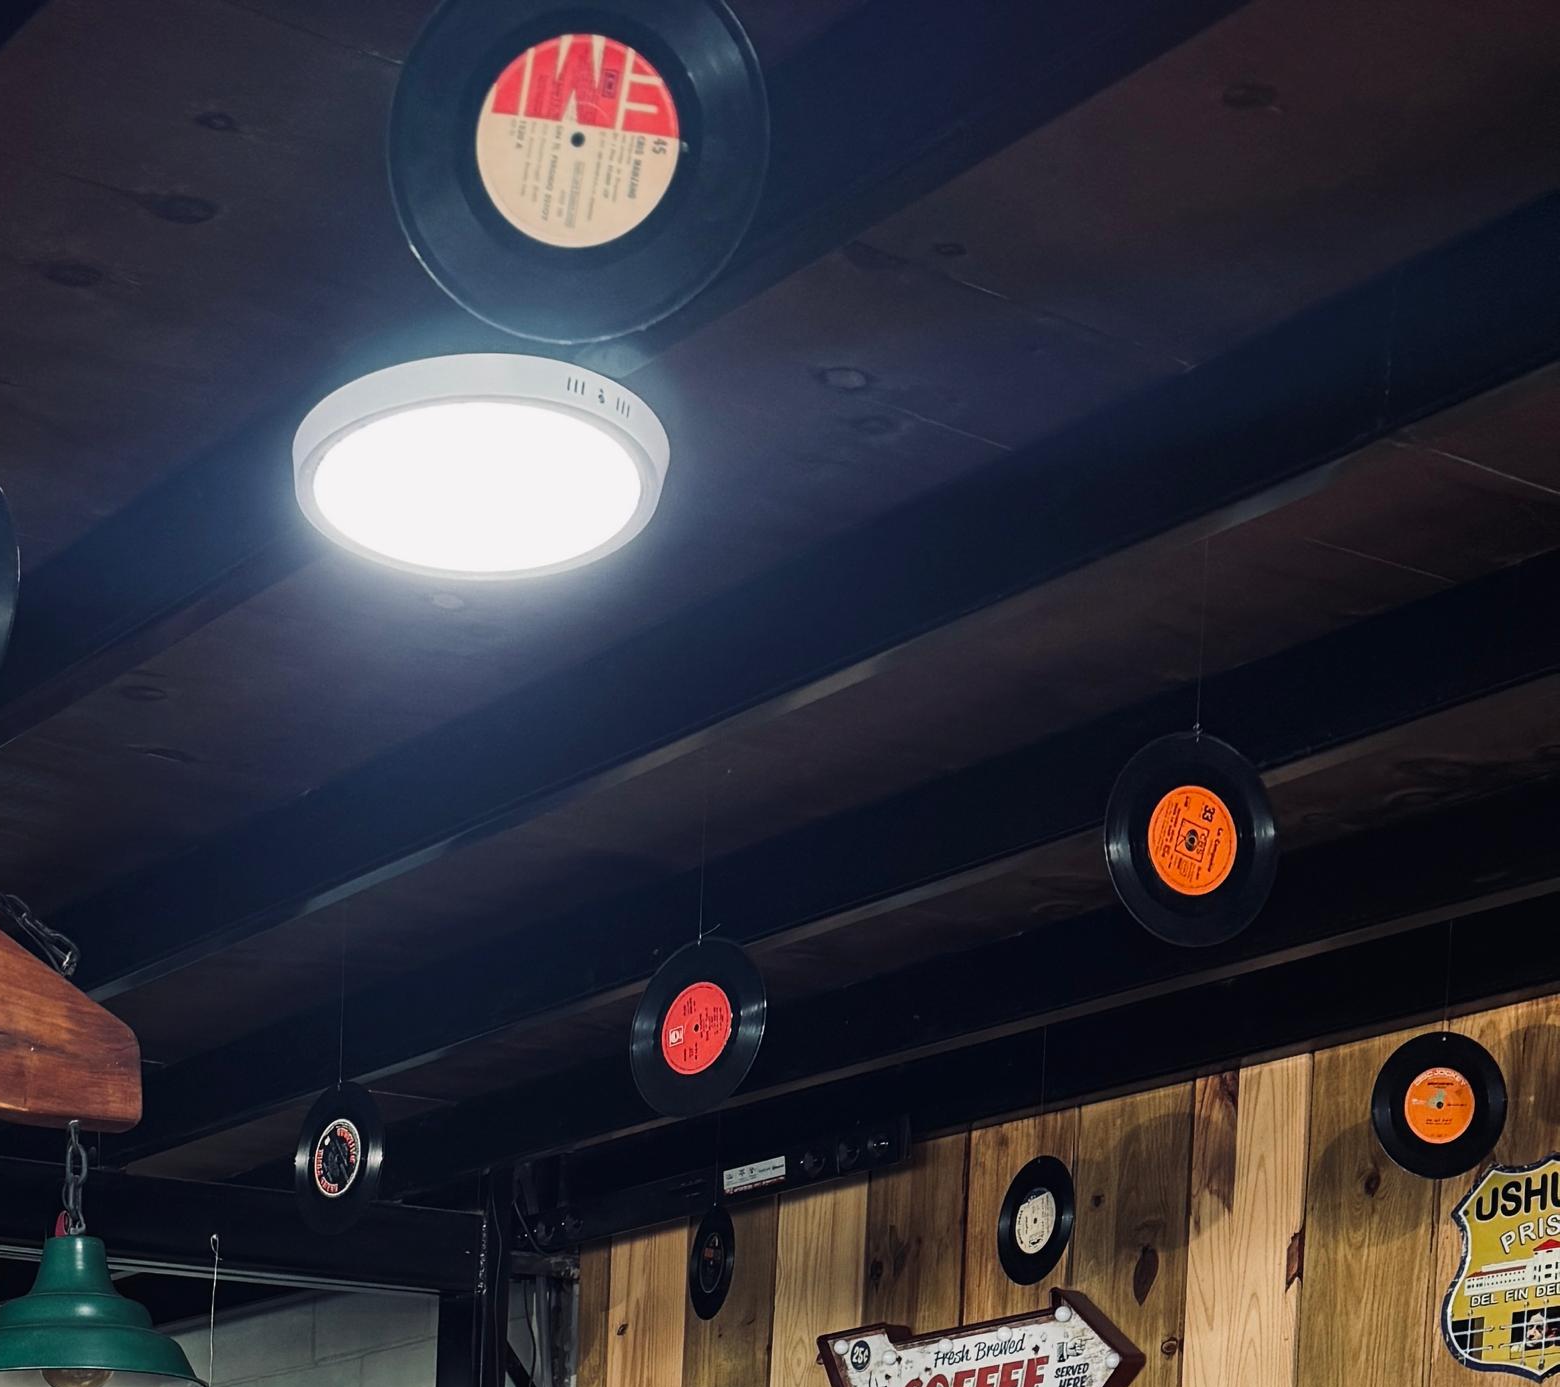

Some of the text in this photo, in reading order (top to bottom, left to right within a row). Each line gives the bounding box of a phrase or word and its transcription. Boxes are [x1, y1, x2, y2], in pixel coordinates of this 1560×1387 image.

[1471, 1294, 1499, 1308] DEL
[1505, 1287, 1529, 1303] FIN
[933, 1333, 1026, 1368] Fresh Brewed
[1054, 1362, 1090, 1379] SERVED
